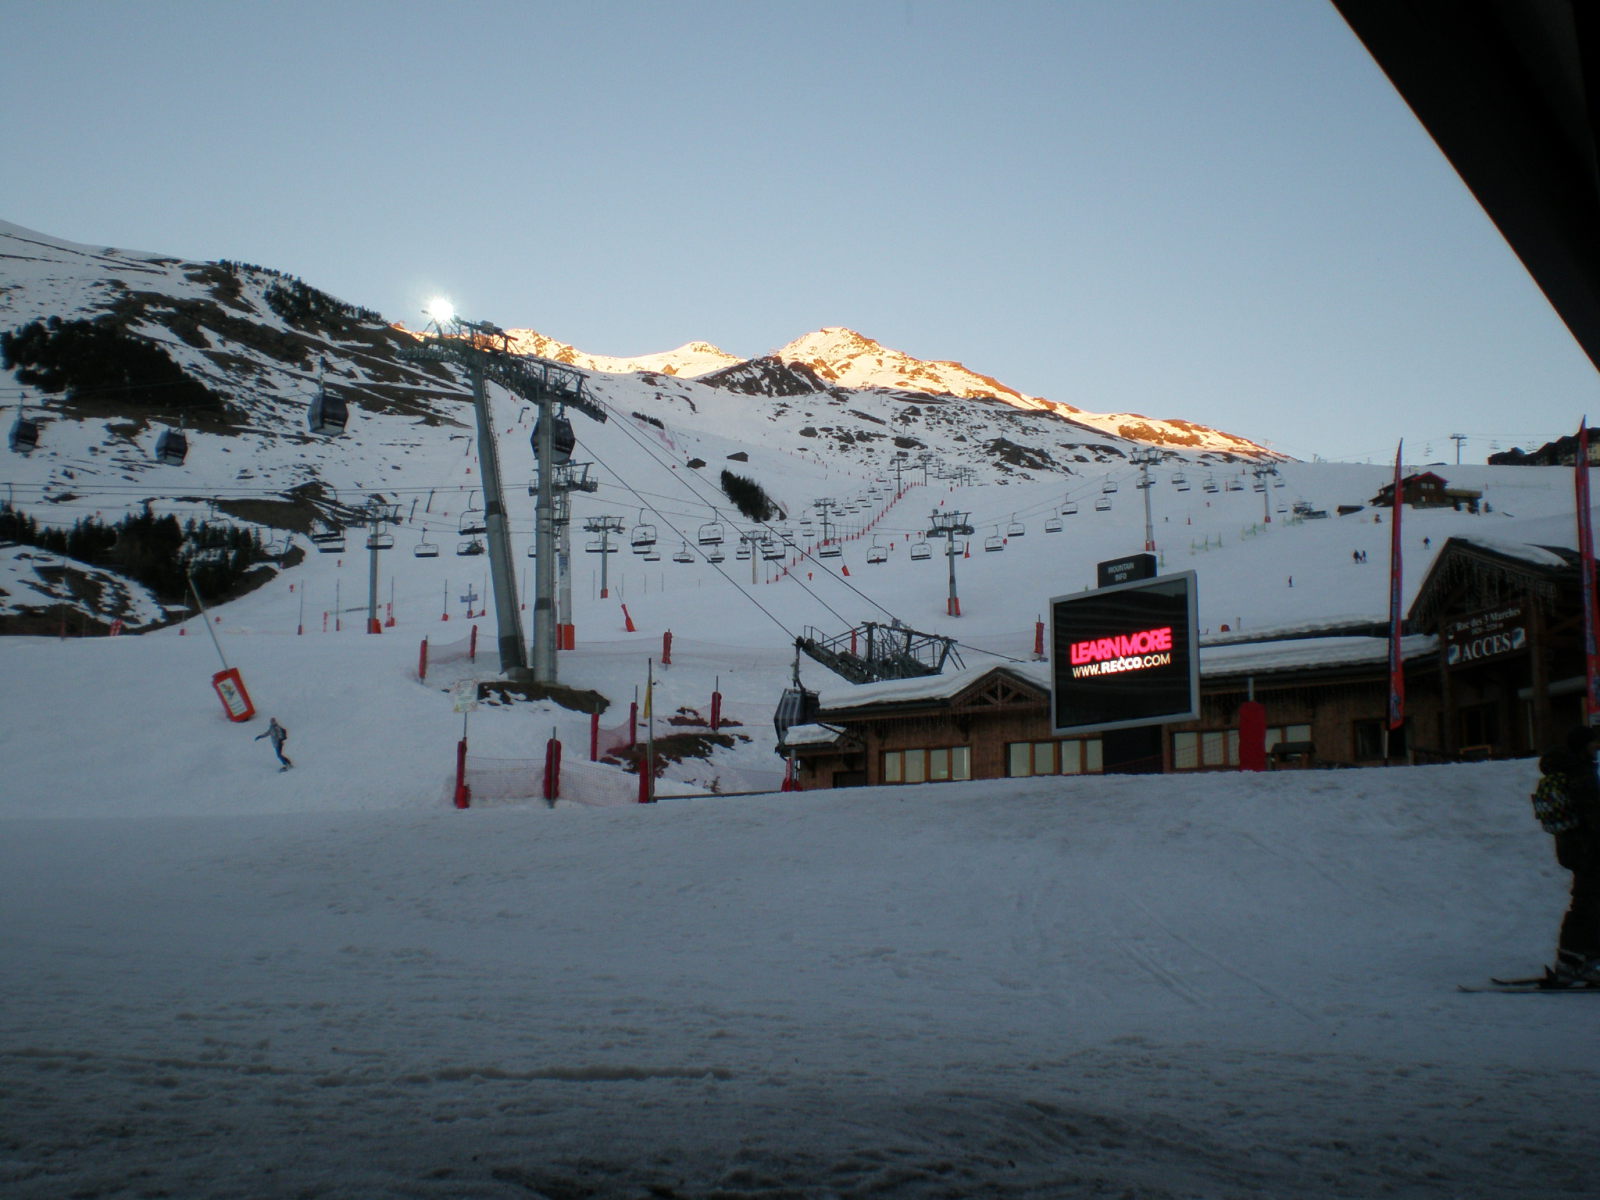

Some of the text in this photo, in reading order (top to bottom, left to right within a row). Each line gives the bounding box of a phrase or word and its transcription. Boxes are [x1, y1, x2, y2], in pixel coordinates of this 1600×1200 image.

[1108, 563, 1134, 574] MOUNTAIN
[1115, 573, 1127, 582] INFO
[1071, 627, 1172, 664] LEARN MORE
[1462, 632, 1511, 661] ACCES
[1072, 653, 1171, 679] WWW.RECCO.COM
